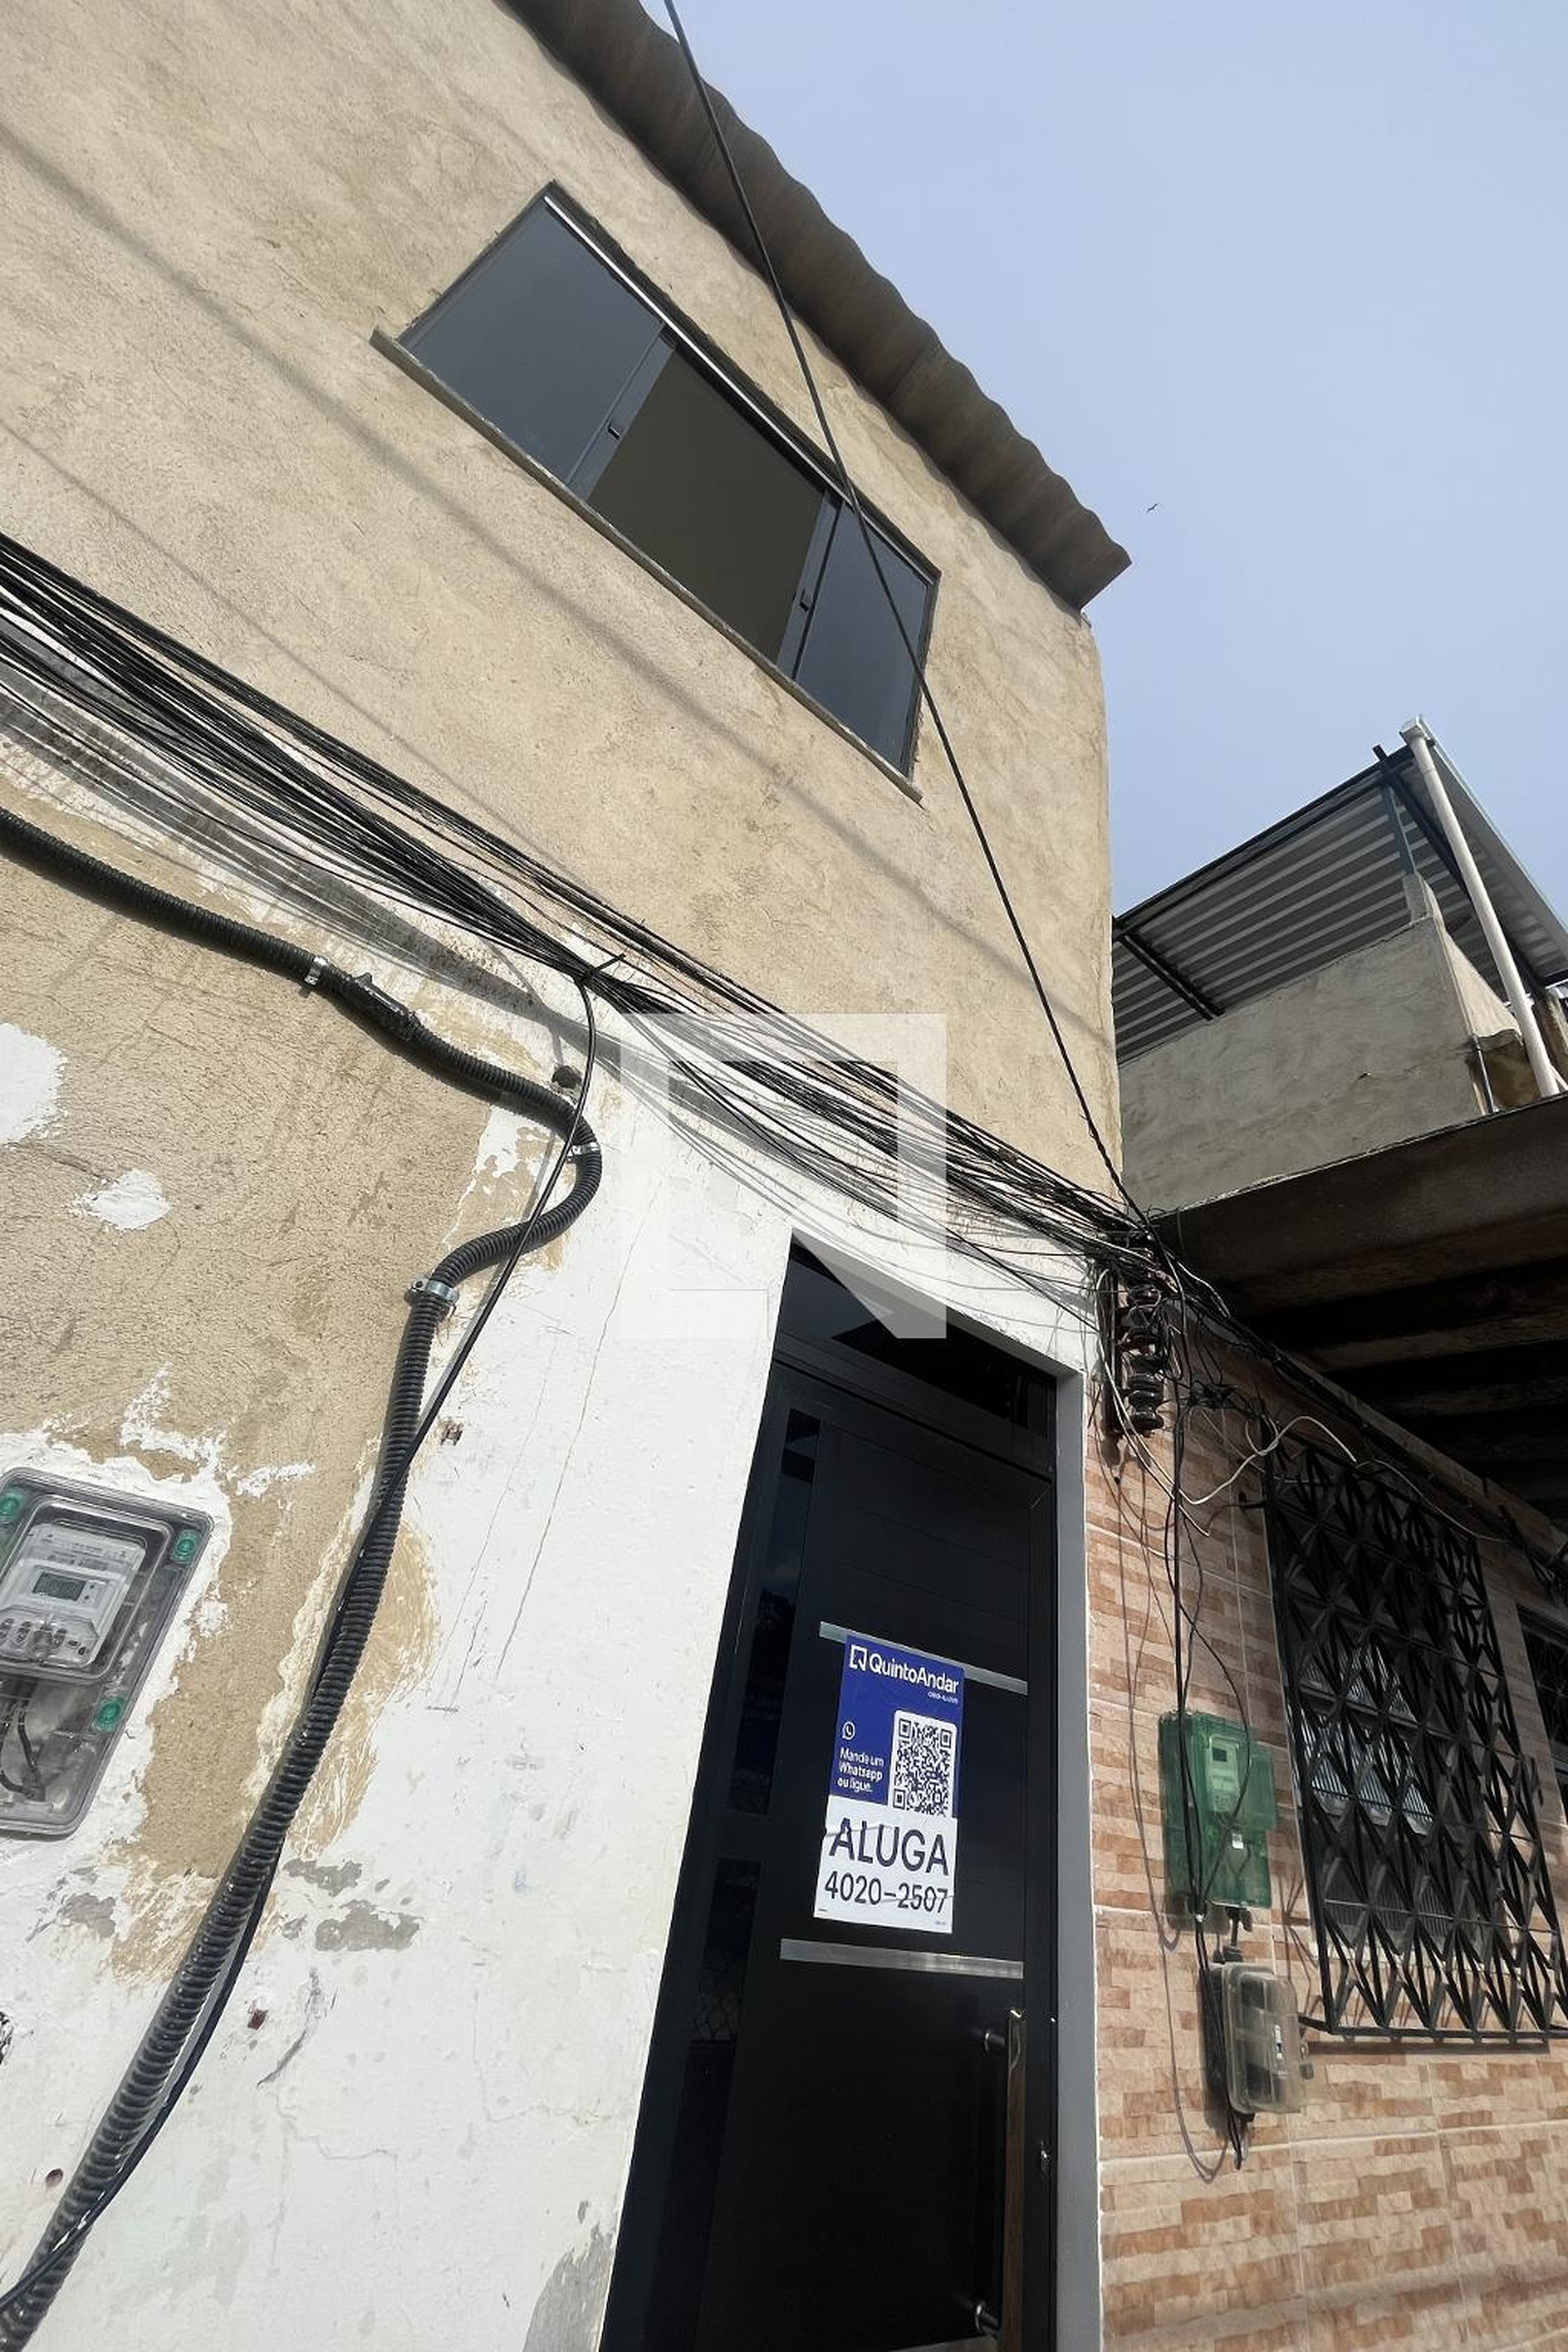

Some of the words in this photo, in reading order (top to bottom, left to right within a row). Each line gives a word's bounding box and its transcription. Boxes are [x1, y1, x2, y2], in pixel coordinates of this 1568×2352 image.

[869, 1653, 959, 1694] QuintoAndar
[840, 1746, 869, 1764] Manda
[837, 1777, 849, 1788] ou
[839, 1761, 883, 1782] Whatsapp
[829, 1817, 949, 1876] ALUGA
[824, 1871, 948, 1913] 4020-2507
